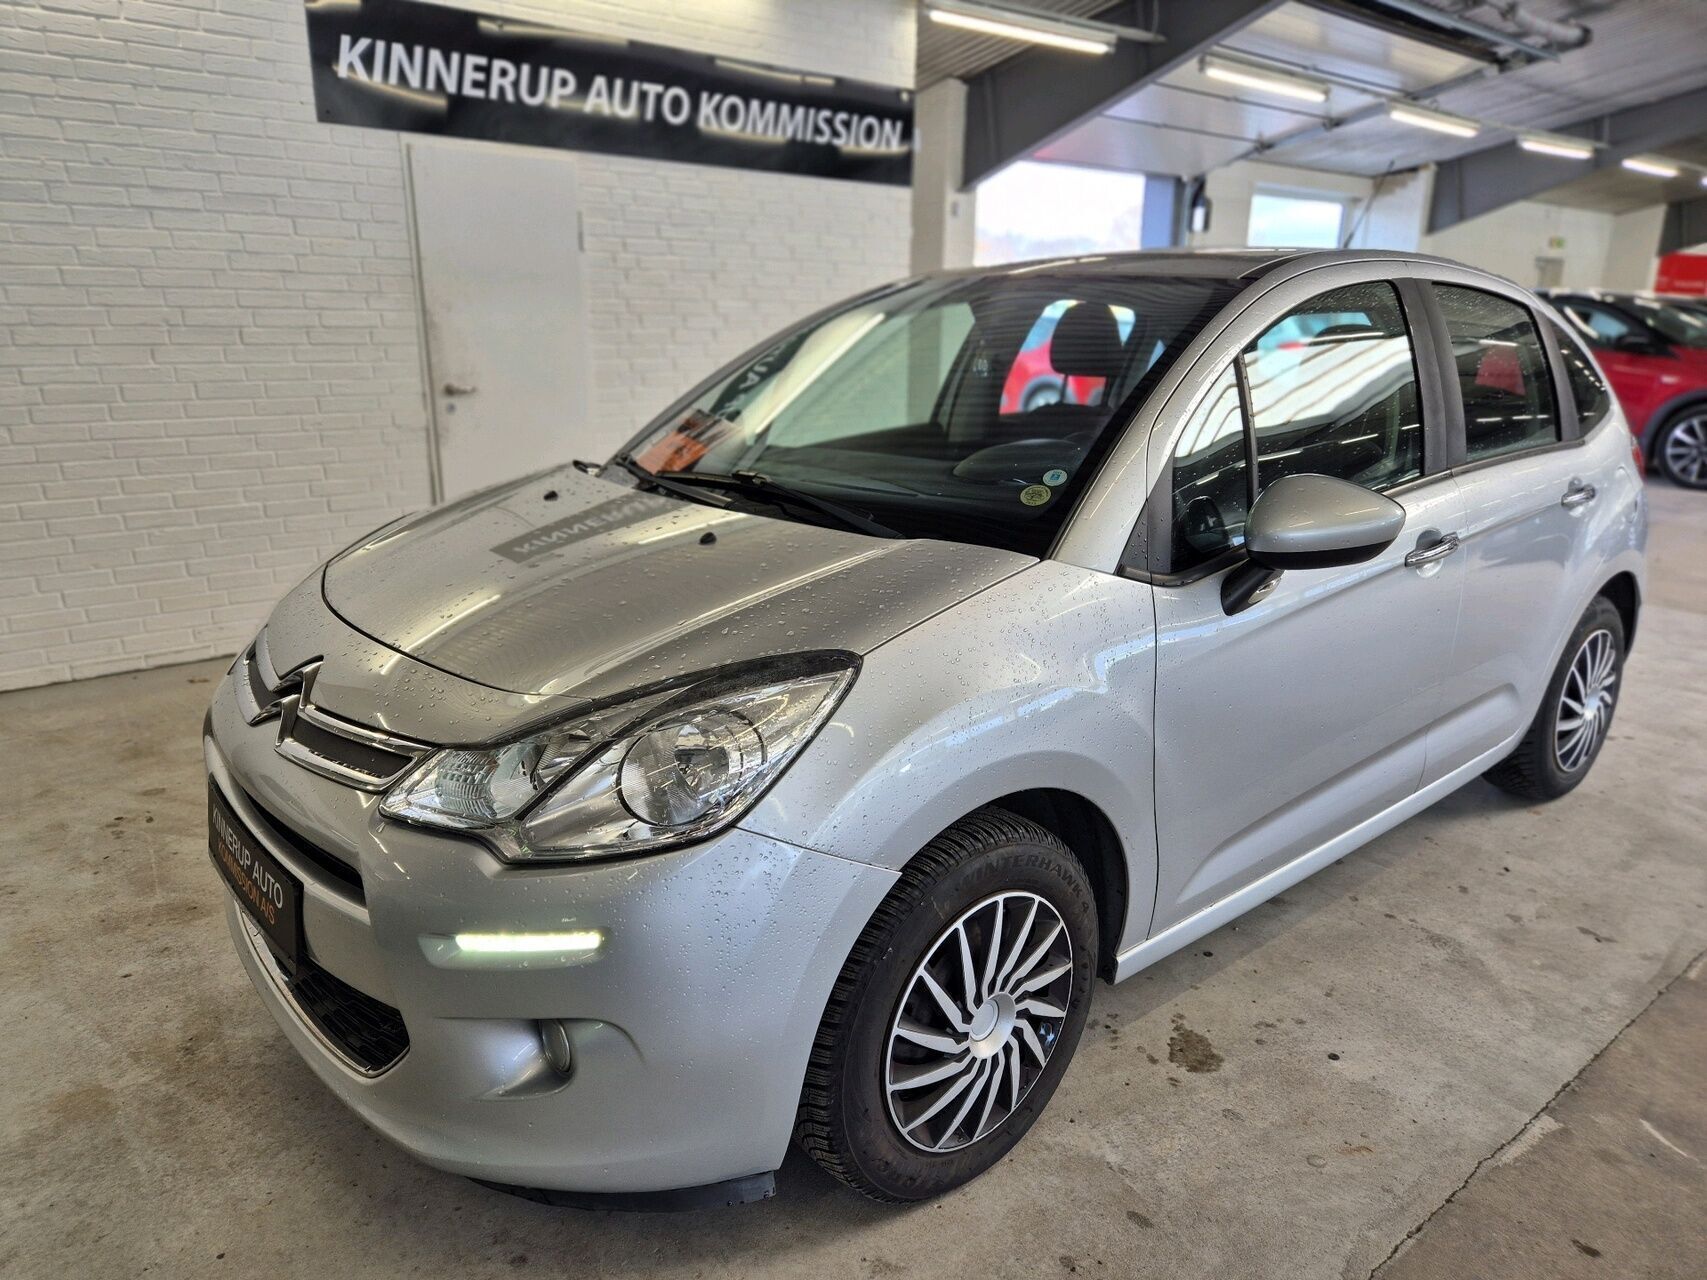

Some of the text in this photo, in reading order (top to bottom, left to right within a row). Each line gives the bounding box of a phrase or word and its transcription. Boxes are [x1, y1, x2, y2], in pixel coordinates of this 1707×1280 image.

[337, 33, 577, 109] KINNERUP
[583, 74, 691, 125] AUTO
[697, 91, 904, 152] KOMMISSION
[213, 807, 283, 909] KINNERUP AUTO
